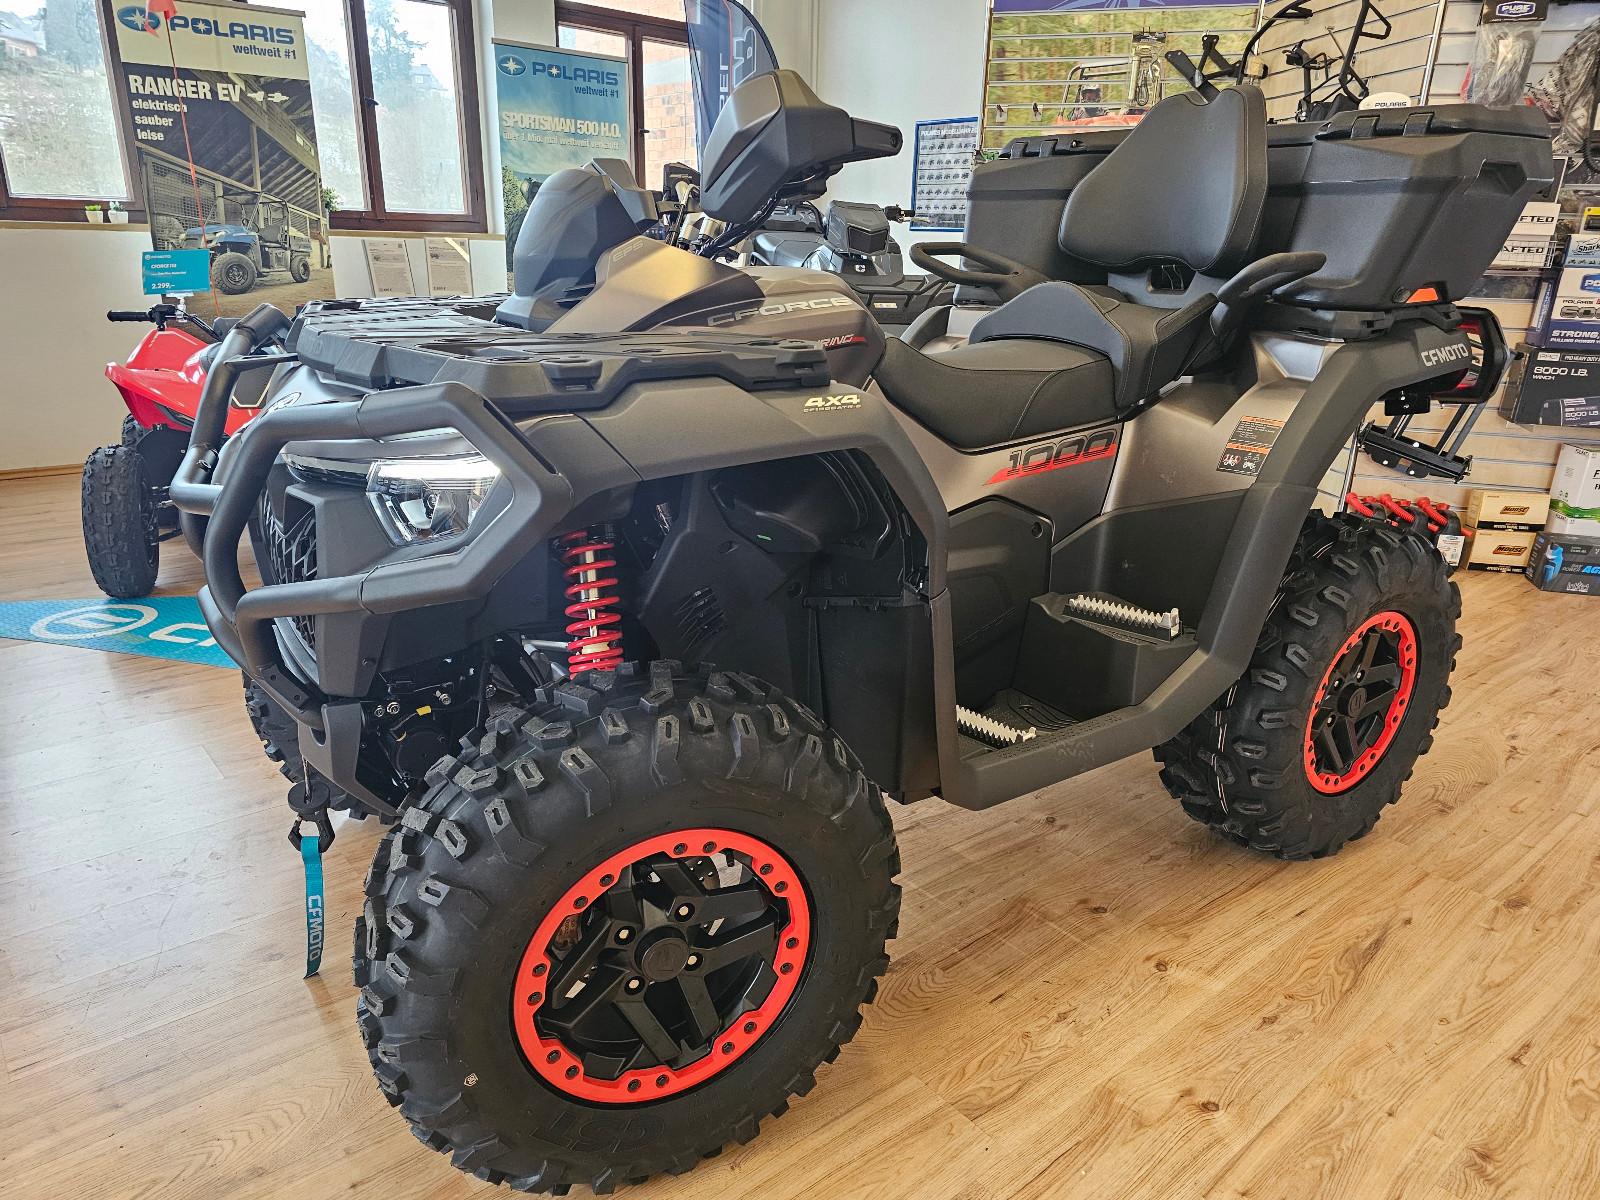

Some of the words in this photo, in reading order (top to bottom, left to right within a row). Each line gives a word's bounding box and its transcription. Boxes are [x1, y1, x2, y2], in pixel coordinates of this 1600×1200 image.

[170, 15, 294, 45] POLARIS
[233, 43, 281, 58] weltweit
[284, 48, 297, 60] #1
[532, 61, 619, 86] POLARIS
[128, 74, 212, 101] RANGER
[217, 83, 241, 103] EV
[574, 84, 608, 98] weltweit
[610, 89, 619, 99] #1
[132, 99, 188, 113] elektrisch
[135, 114, 173, 127] sauber
[503, 112, 575, 133] SPORTSMAN
[577, 119, 599, 136] 500
[137, 128, 165, 141] leise
[707, 297, 852, 327] CFORCE
[1420, 343, 1469, 367] CFMOTO
[1007, 428, 1118, 476] 1000
[308, 894, 323, 962] CFMOTO
